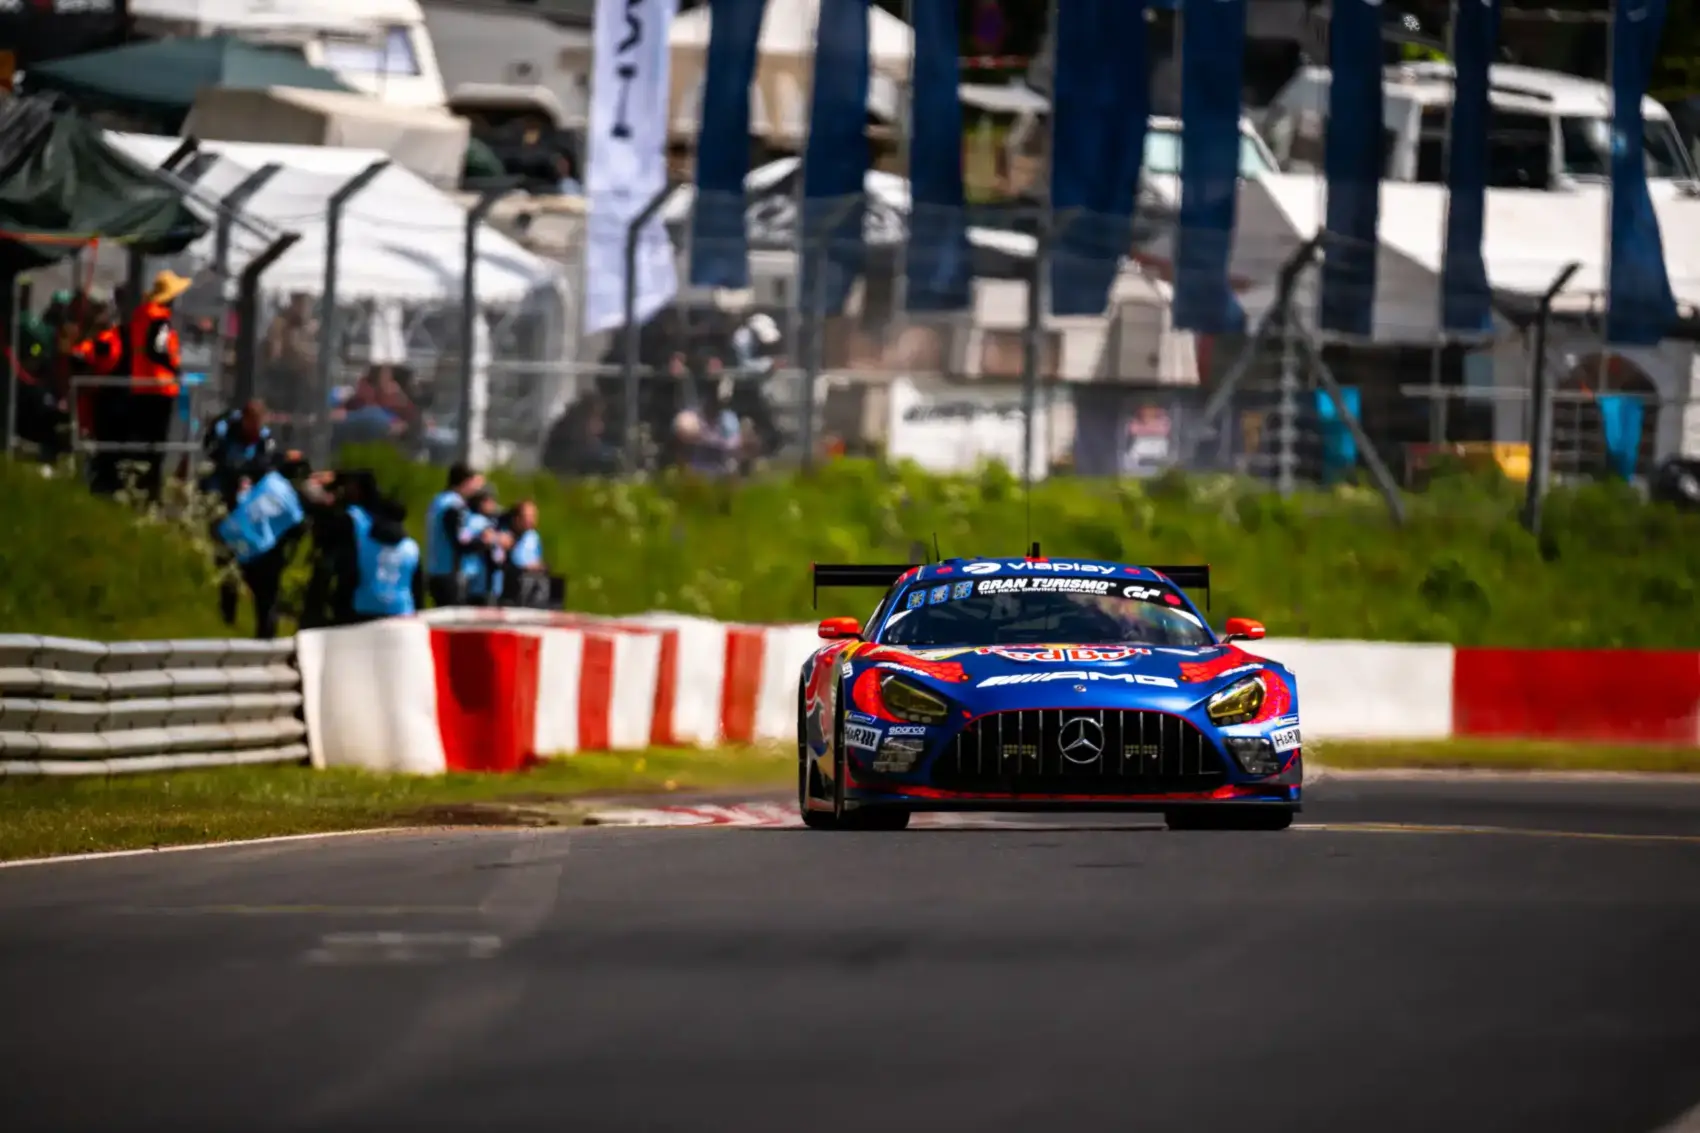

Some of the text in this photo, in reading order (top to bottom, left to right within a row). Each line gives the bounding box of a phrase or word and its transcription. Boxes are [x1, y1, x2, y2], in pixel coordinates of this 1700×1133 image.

[1007, 562, 1116, 575] viaplay
[978, 578, 1028, 591] GRAN
[888, 726, 926, 735] sparco
